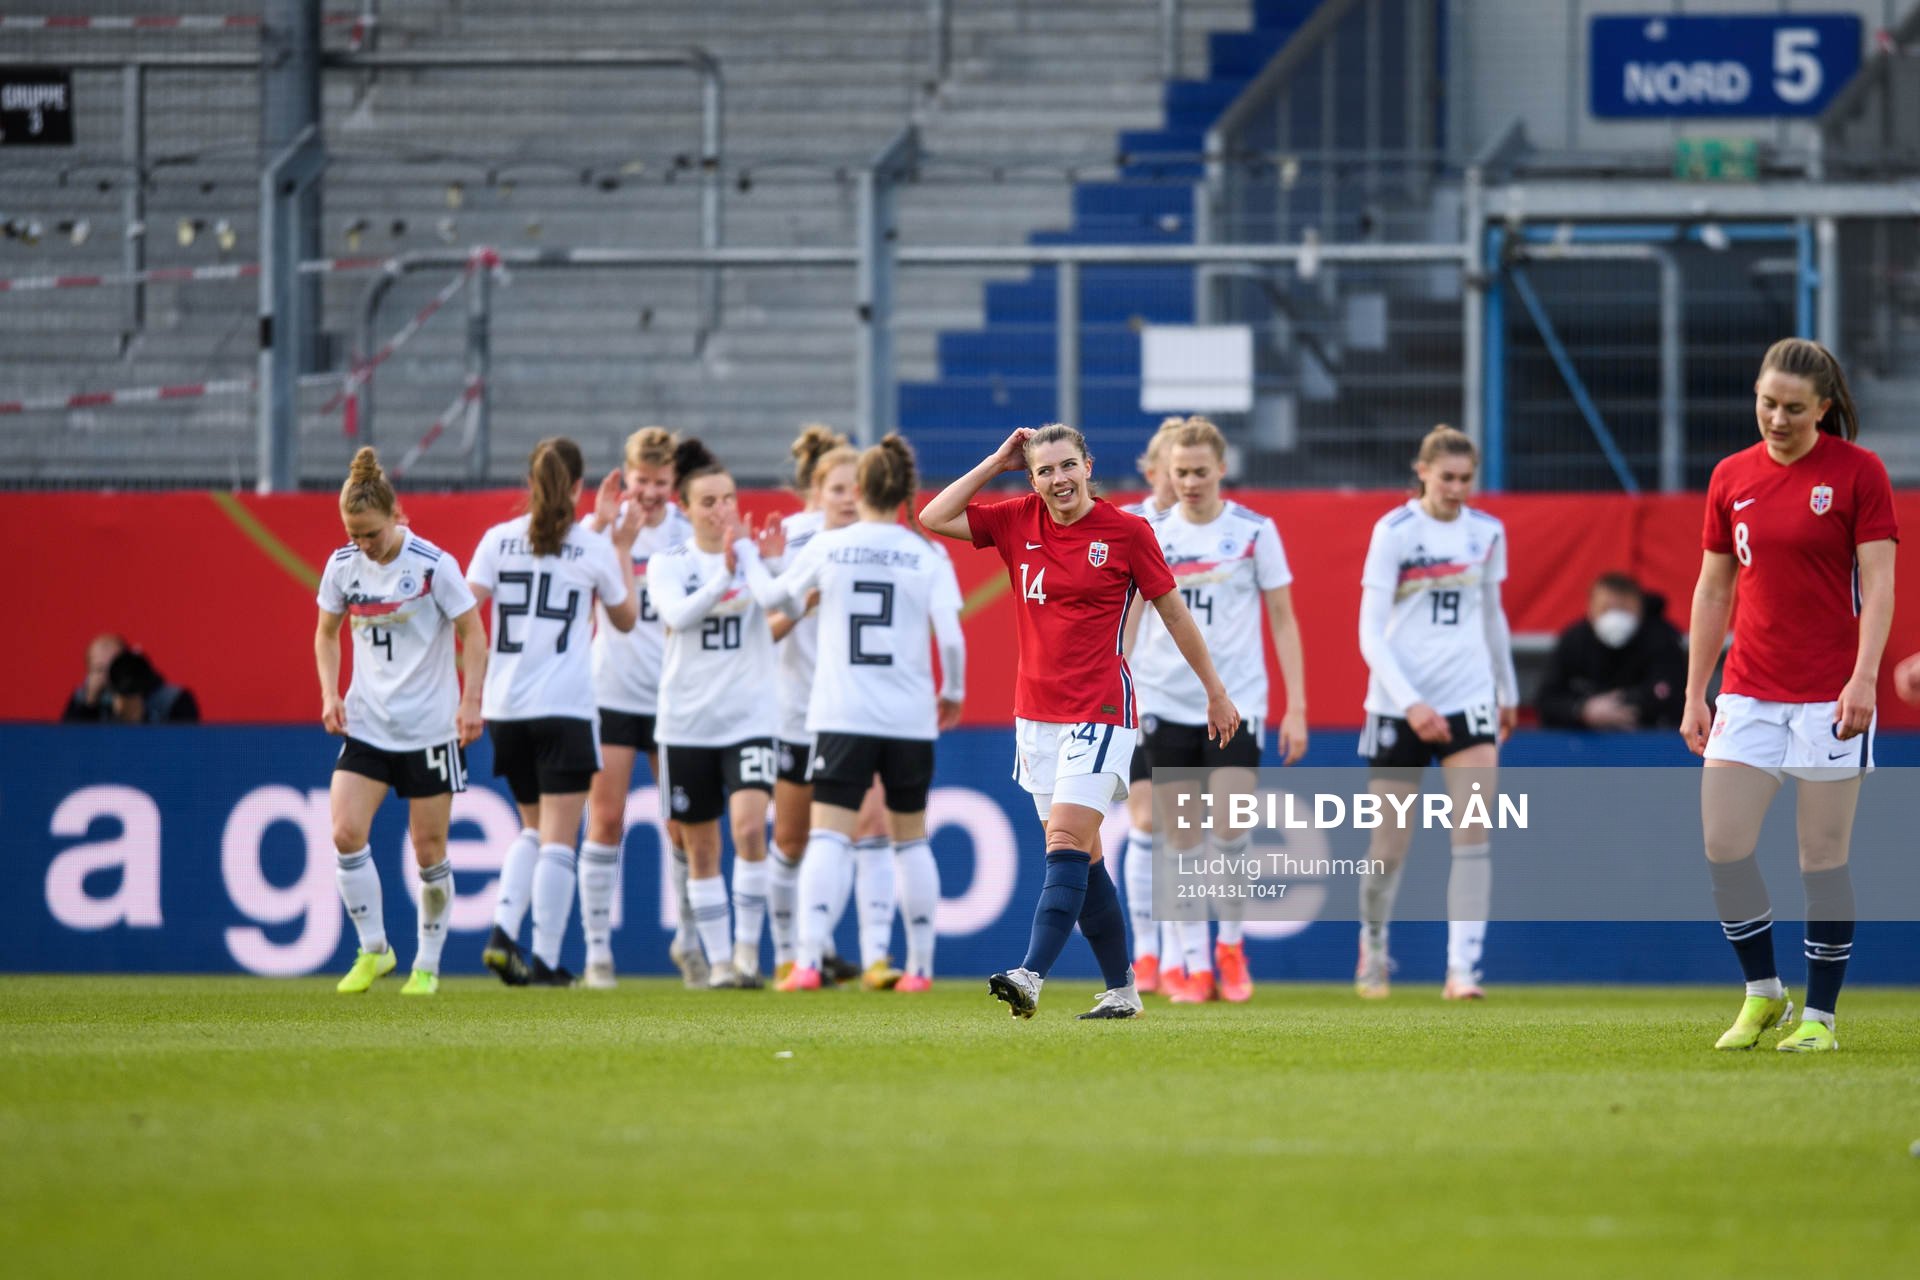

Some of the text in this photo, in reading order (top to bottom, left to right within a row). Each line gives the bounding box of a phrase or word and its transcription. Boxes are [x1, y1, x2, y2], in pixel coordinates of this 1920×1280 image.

[1624, 27, 1822, 103] NORD 5
[1734, 522, 1752, 567] 8
[1019, 563, 1047, 605] 14
[497, 571, 580, 654] 24
[849, 581, 894, 666] 2
[1430, 590, 1461, 625] 19
[372, 626, 393, 662] 4
[702, 615, 741, 650] 20
[425, 747, 449, 782] 4
[740, 746, 777, 784] 20
